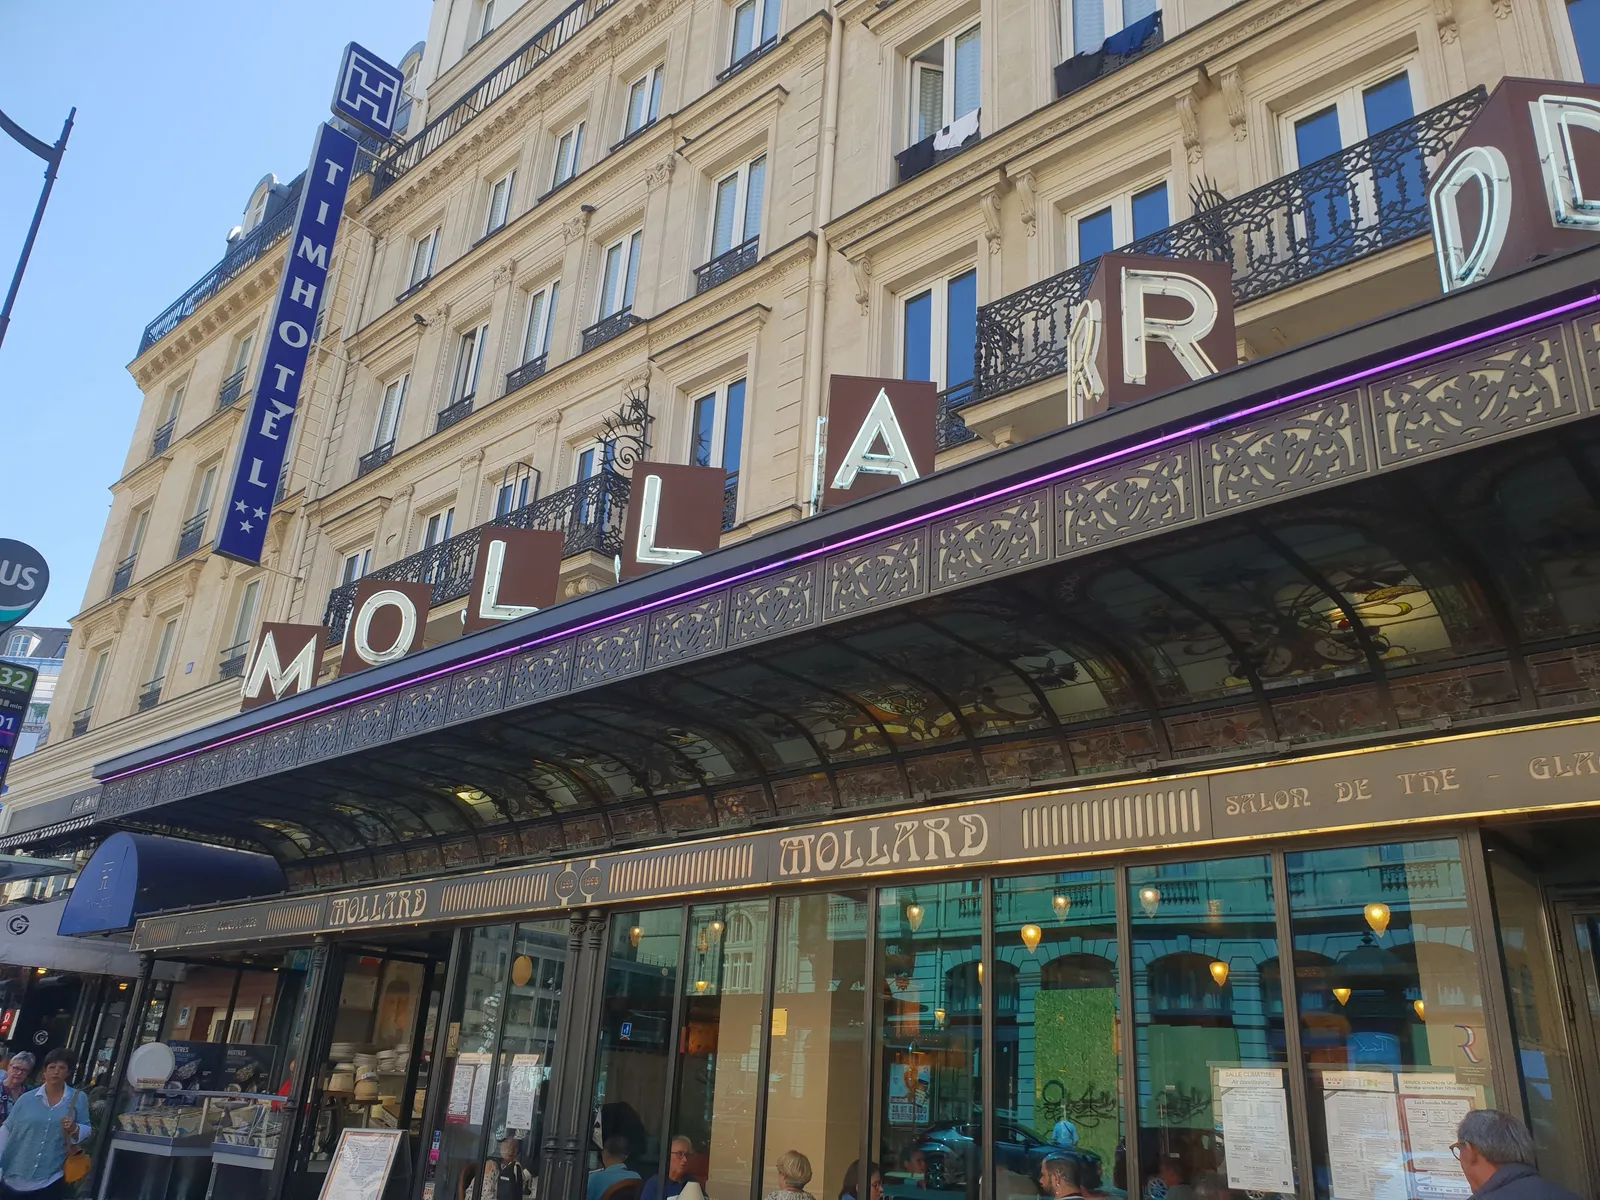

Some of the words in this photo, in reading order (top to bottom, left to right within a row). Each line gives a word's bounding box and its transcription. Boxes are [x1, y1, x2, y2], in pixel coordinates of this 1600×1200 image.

[1225, 787, 1311, 816] SALON
[1334, 778, 1372, 803] DE
[1528, 751, 1600, 780] GLA
[779, 813, 989, 876] MOLLARD
[329, 888, 427, 926] MOLLARD
